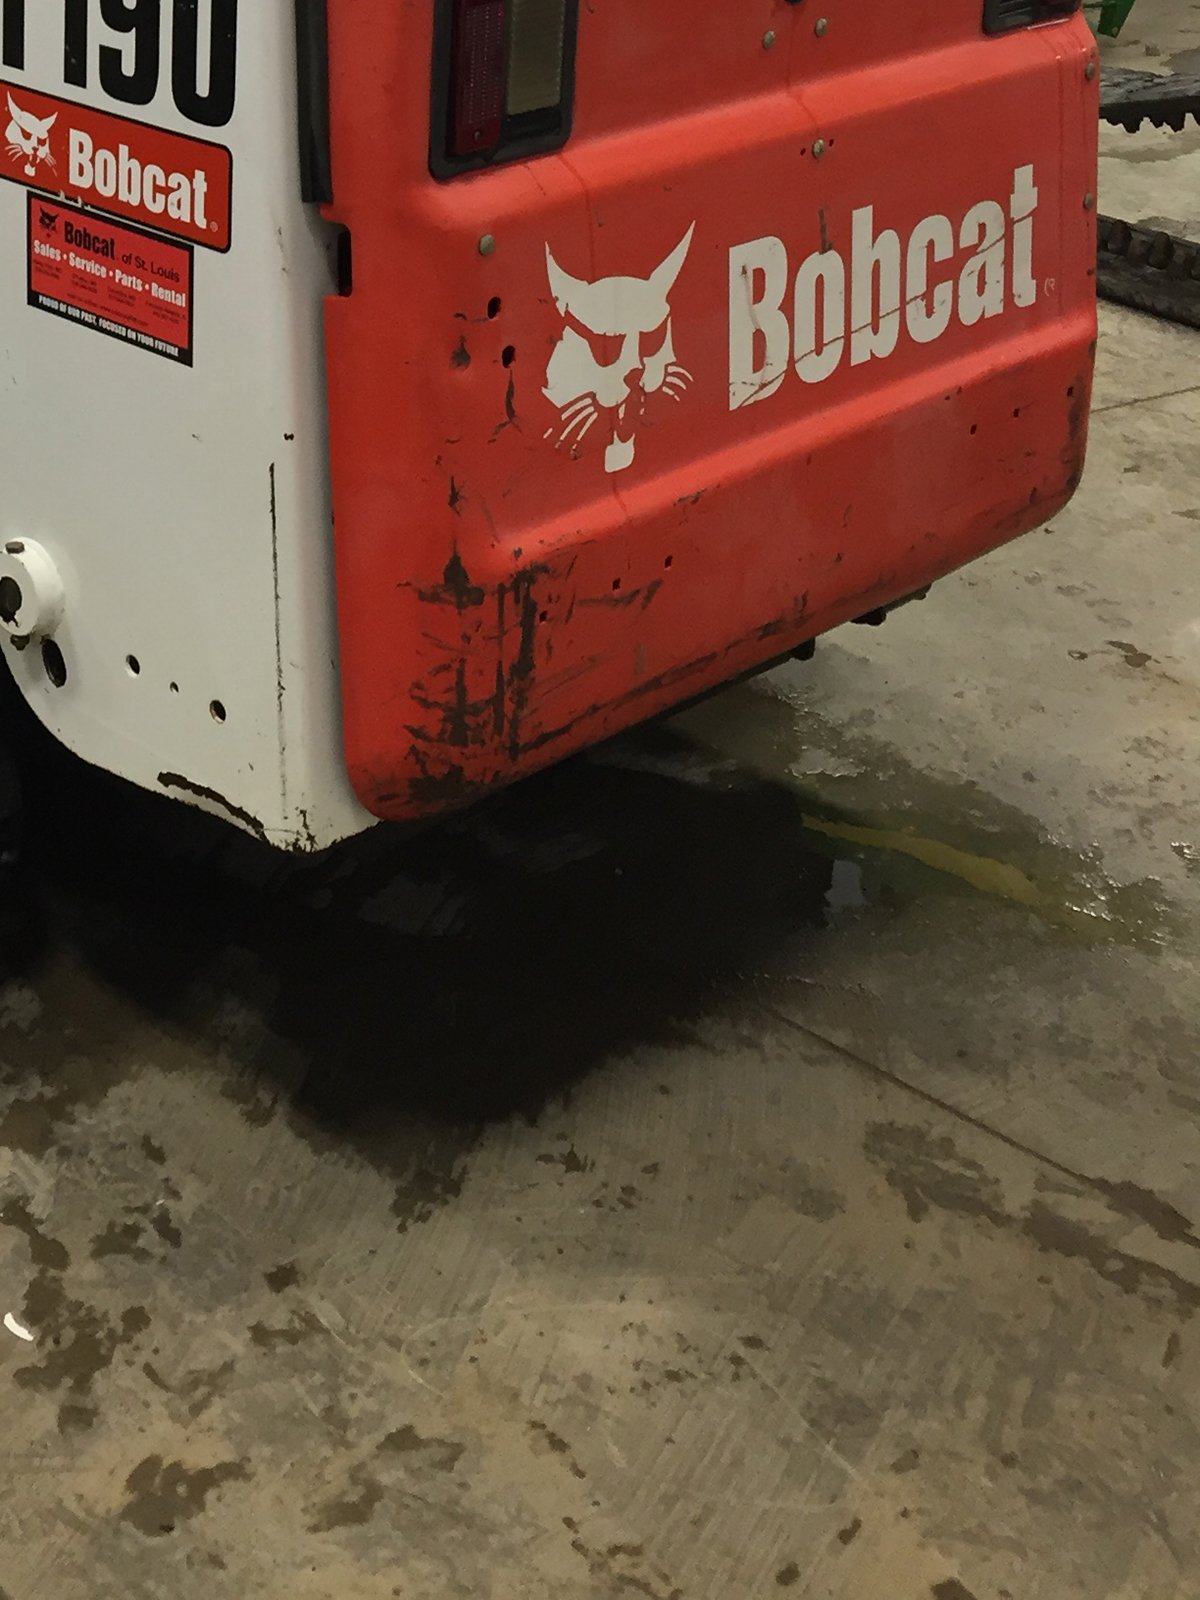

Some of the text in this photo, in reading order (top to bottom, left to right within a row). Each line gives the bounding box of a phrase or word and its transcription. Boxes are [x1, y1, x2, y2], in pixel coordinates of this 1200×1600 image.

[68, 128, 208, 229] Bobcat
[33, 239, 61, 261] Sales
[68, 252, 107, 278] Service
[114, 269, 143, 292] Parts
[151, 282, 186, 308] Rental
[64, 221, 115, 260] Bobcat
[121, 253, 132, 265] of
[150, 261, 180, 283] Louis
[729, 163, 1038, 411] Bobcat
[38, 295, 59, 310] PROUD
[59, 303, 67, 314] OF
[67, 305, 81, 319] OUR
[99, 316, 126, 337] FOCUSED
[127, 328, 136, 341] ON
[137, 331, 155, 347] YOUR
[155, 338, 179, 357] FUTURE
